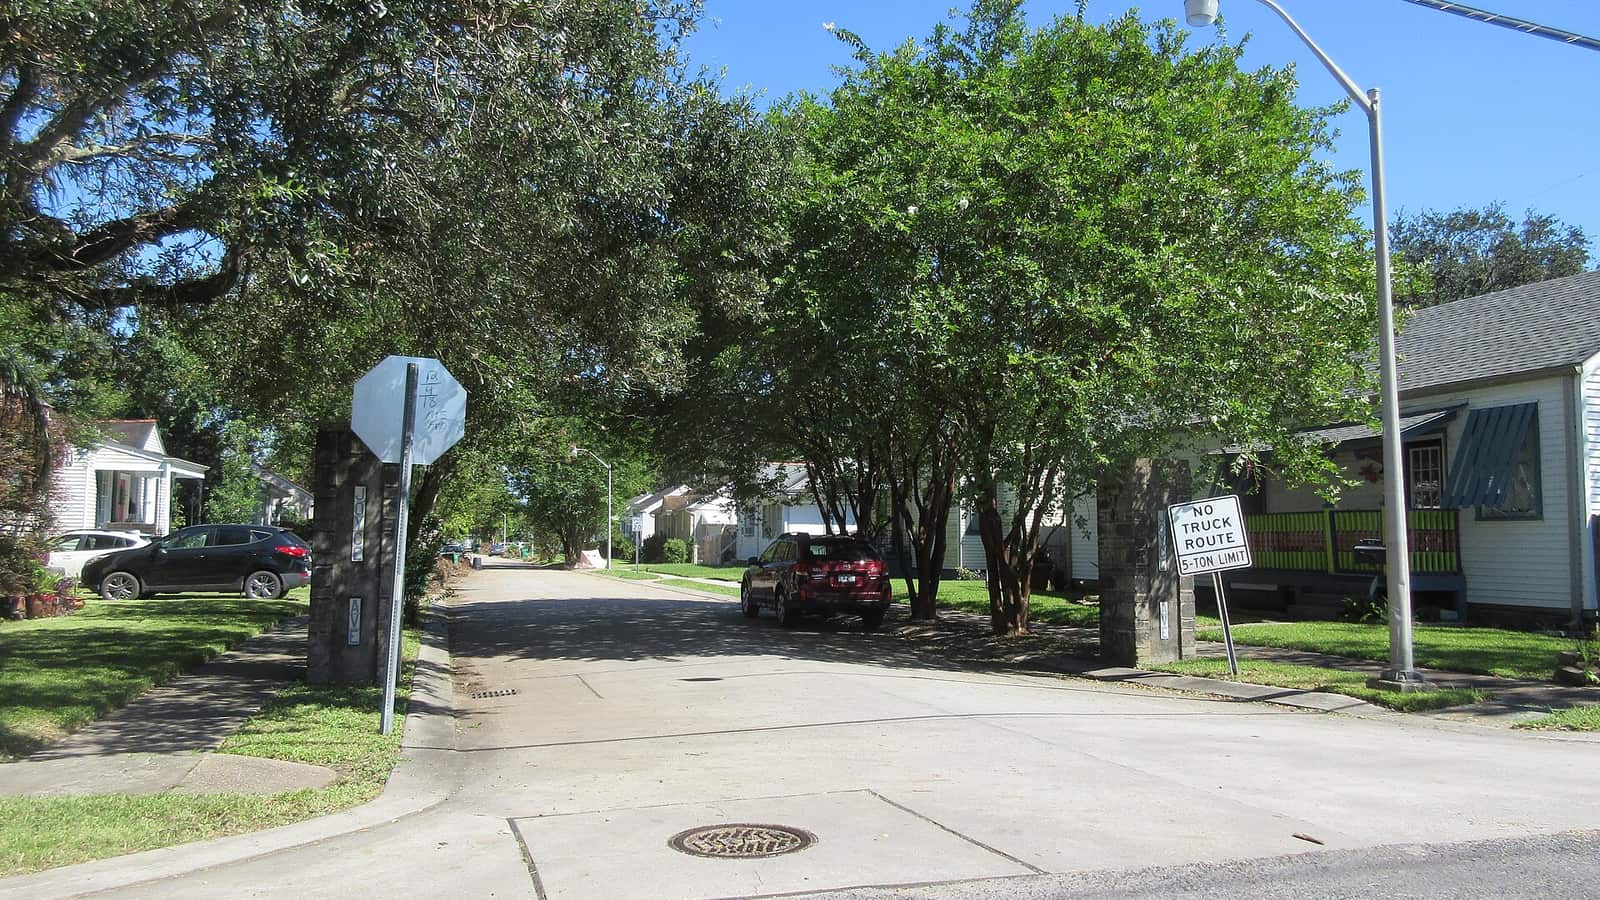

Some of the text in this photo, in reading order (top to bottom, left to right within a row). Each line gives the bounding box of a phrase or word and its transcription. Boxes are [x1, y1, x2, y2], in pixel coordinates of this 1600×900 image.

[1193, 505, 1213, 517] NO
[1182, 518, 1232, 534] TRUCK
[1185, 532, 1235, 550] ROUTE
[1182, 551, 1244, 570] 5-TON LIMIT
[349, 599, 359, 643] AVE
[1160, 602, 1168, 638] AVE
